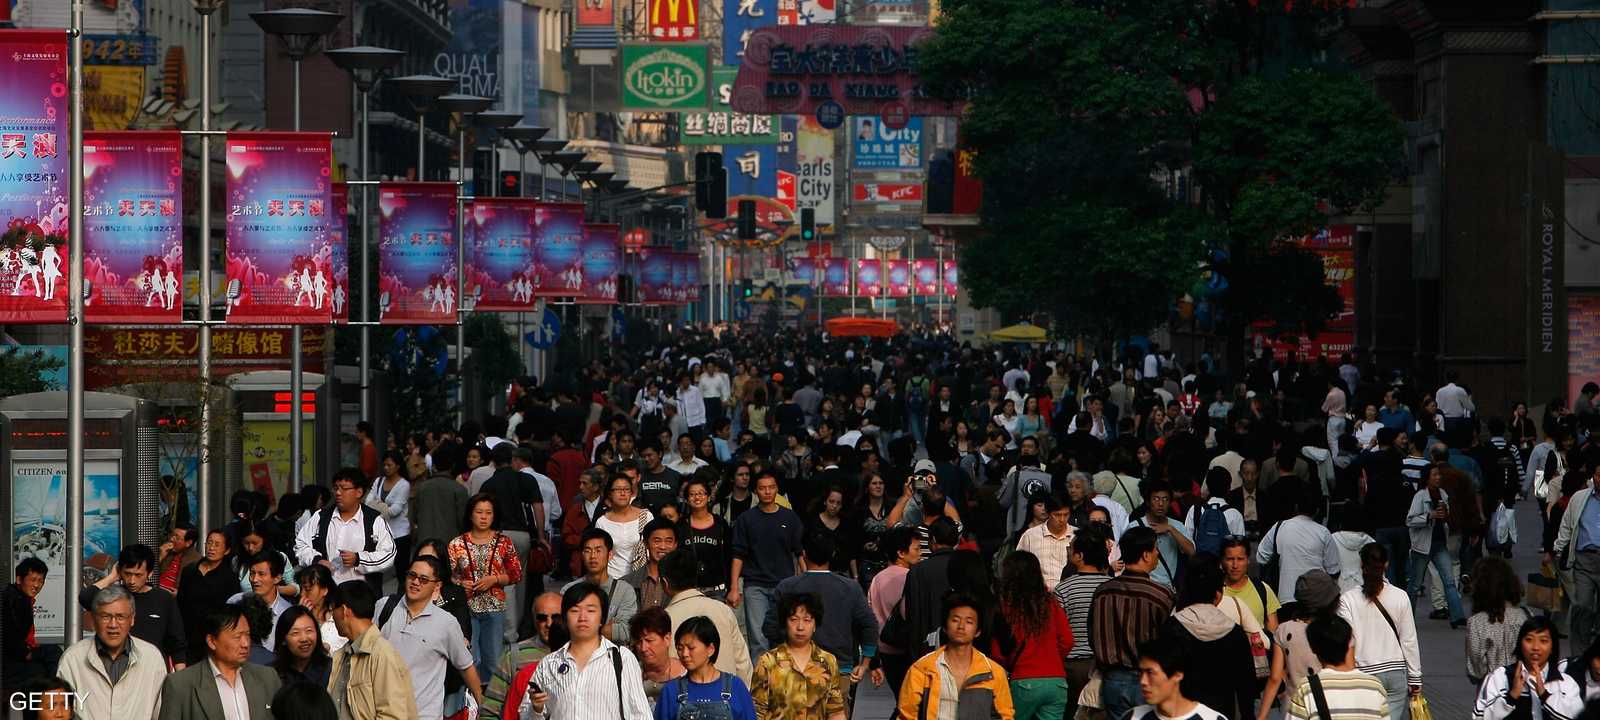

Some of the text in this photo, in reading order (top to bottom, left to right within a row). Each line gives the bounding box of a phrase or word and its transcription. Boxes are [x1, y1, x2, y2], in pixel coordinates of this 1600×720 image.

[637, 66, 693, 95] Itokin
[800, 179, 831, 200] City
[892, 186, 914, 200] KFC
[1542, 223, 1553, 353] ROYAL MERIDIEN
[17, 468, 53, 476] CITIZEN
